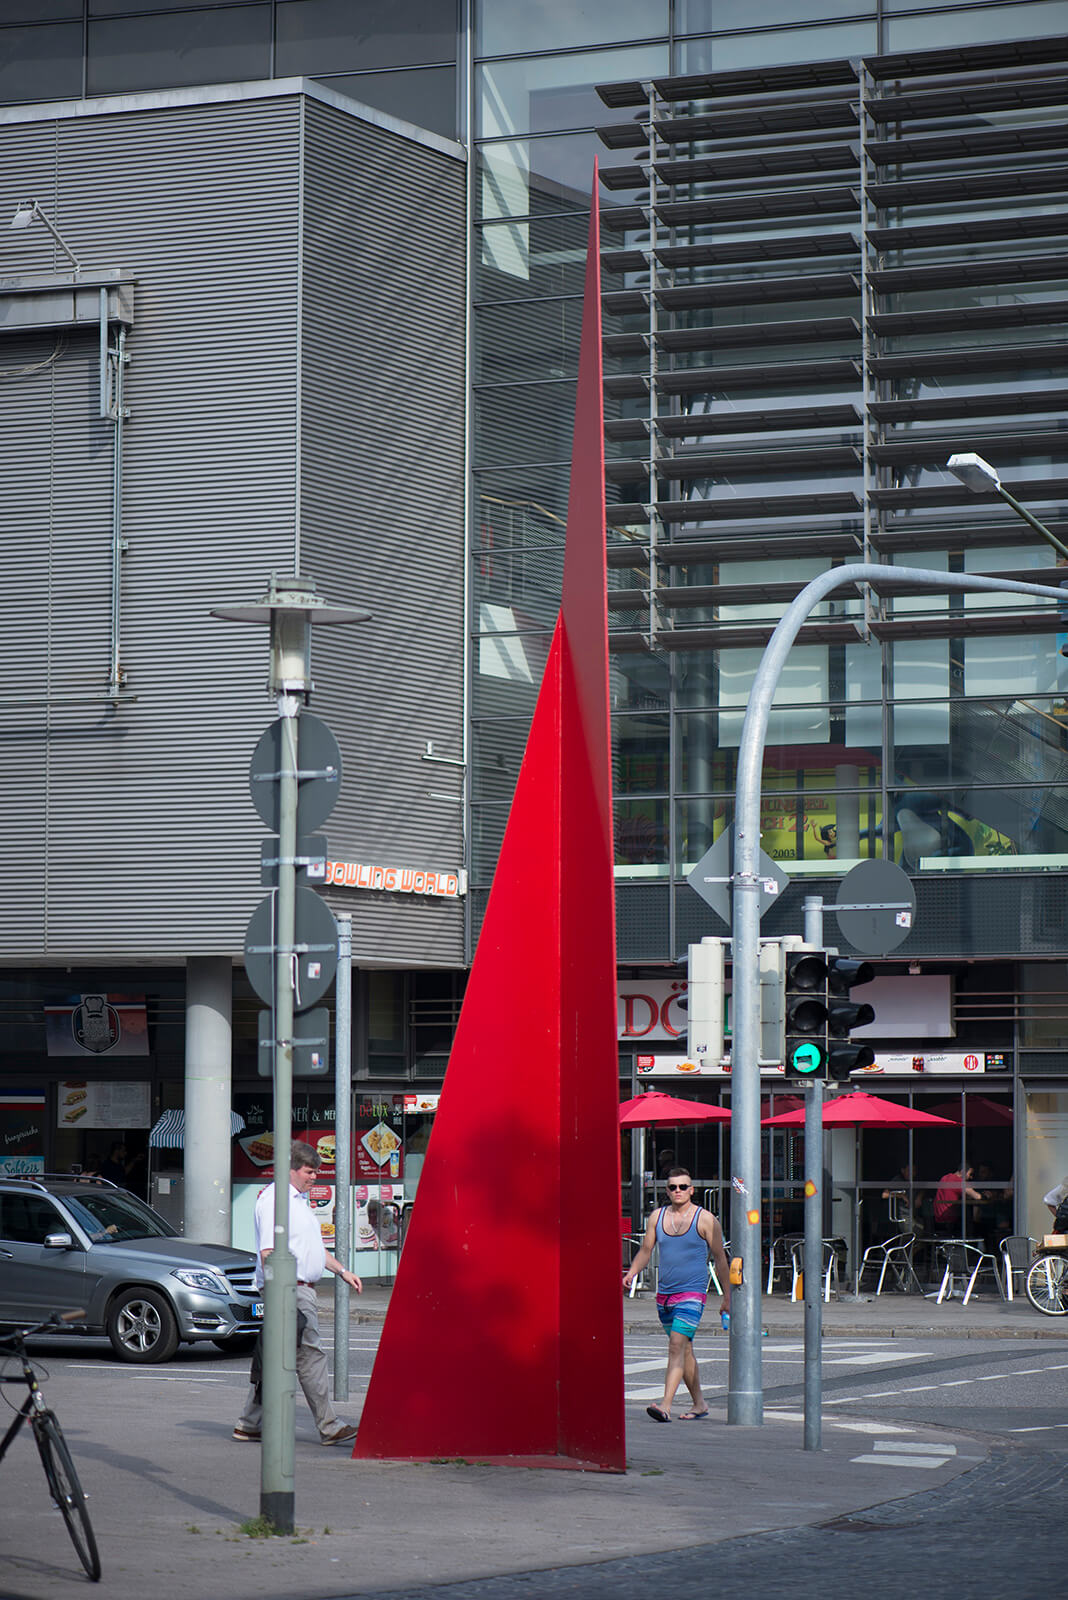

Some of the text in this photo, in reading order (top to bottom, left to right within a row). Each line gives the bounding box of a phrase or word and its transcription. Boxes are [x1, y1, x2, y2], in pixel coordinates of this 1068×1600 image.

[772, 849, 796, 858] 2003
[325, 861, 458, 896] BOWLING WORLD
[312, 1109, 321, 1122] &
